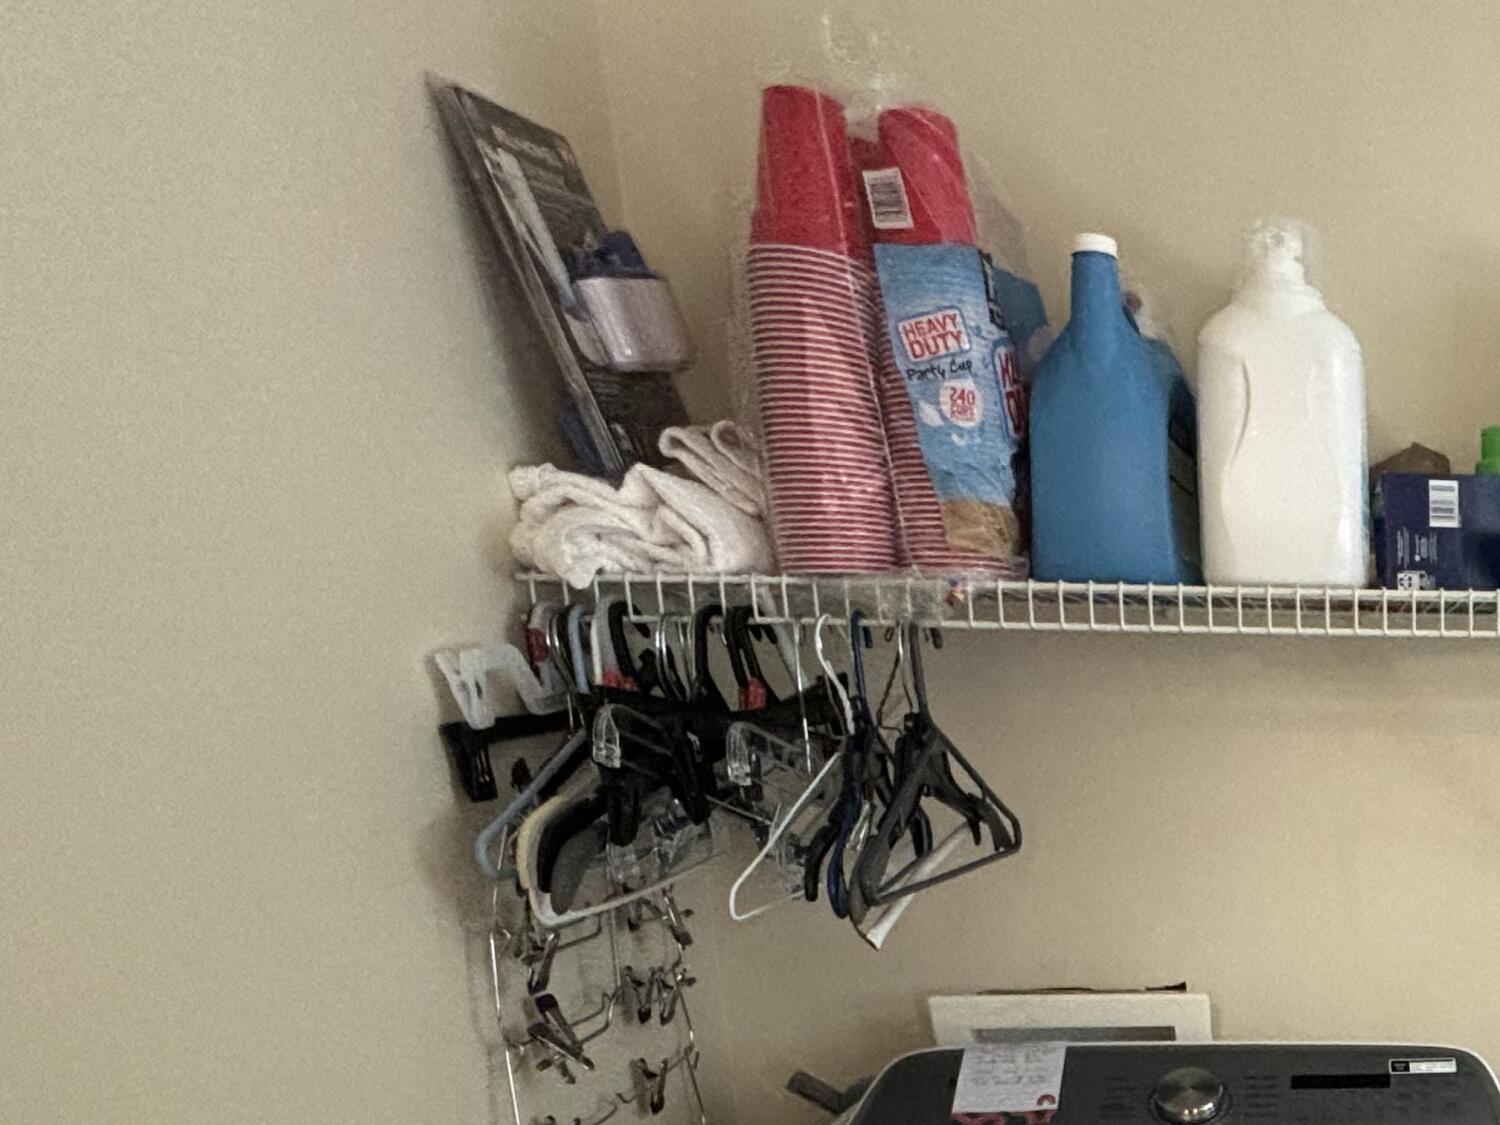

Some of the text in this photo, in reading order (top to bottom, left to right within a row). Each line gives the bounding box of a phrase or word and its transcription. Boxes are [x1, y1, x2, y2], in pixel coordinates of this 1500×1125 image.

[902, 313, 958, 338] HEAVY
[908, 330, 963, 360] DUTY
[905, 359, 973, 382] Party Cup
[949, 386, 976, 406] 240
